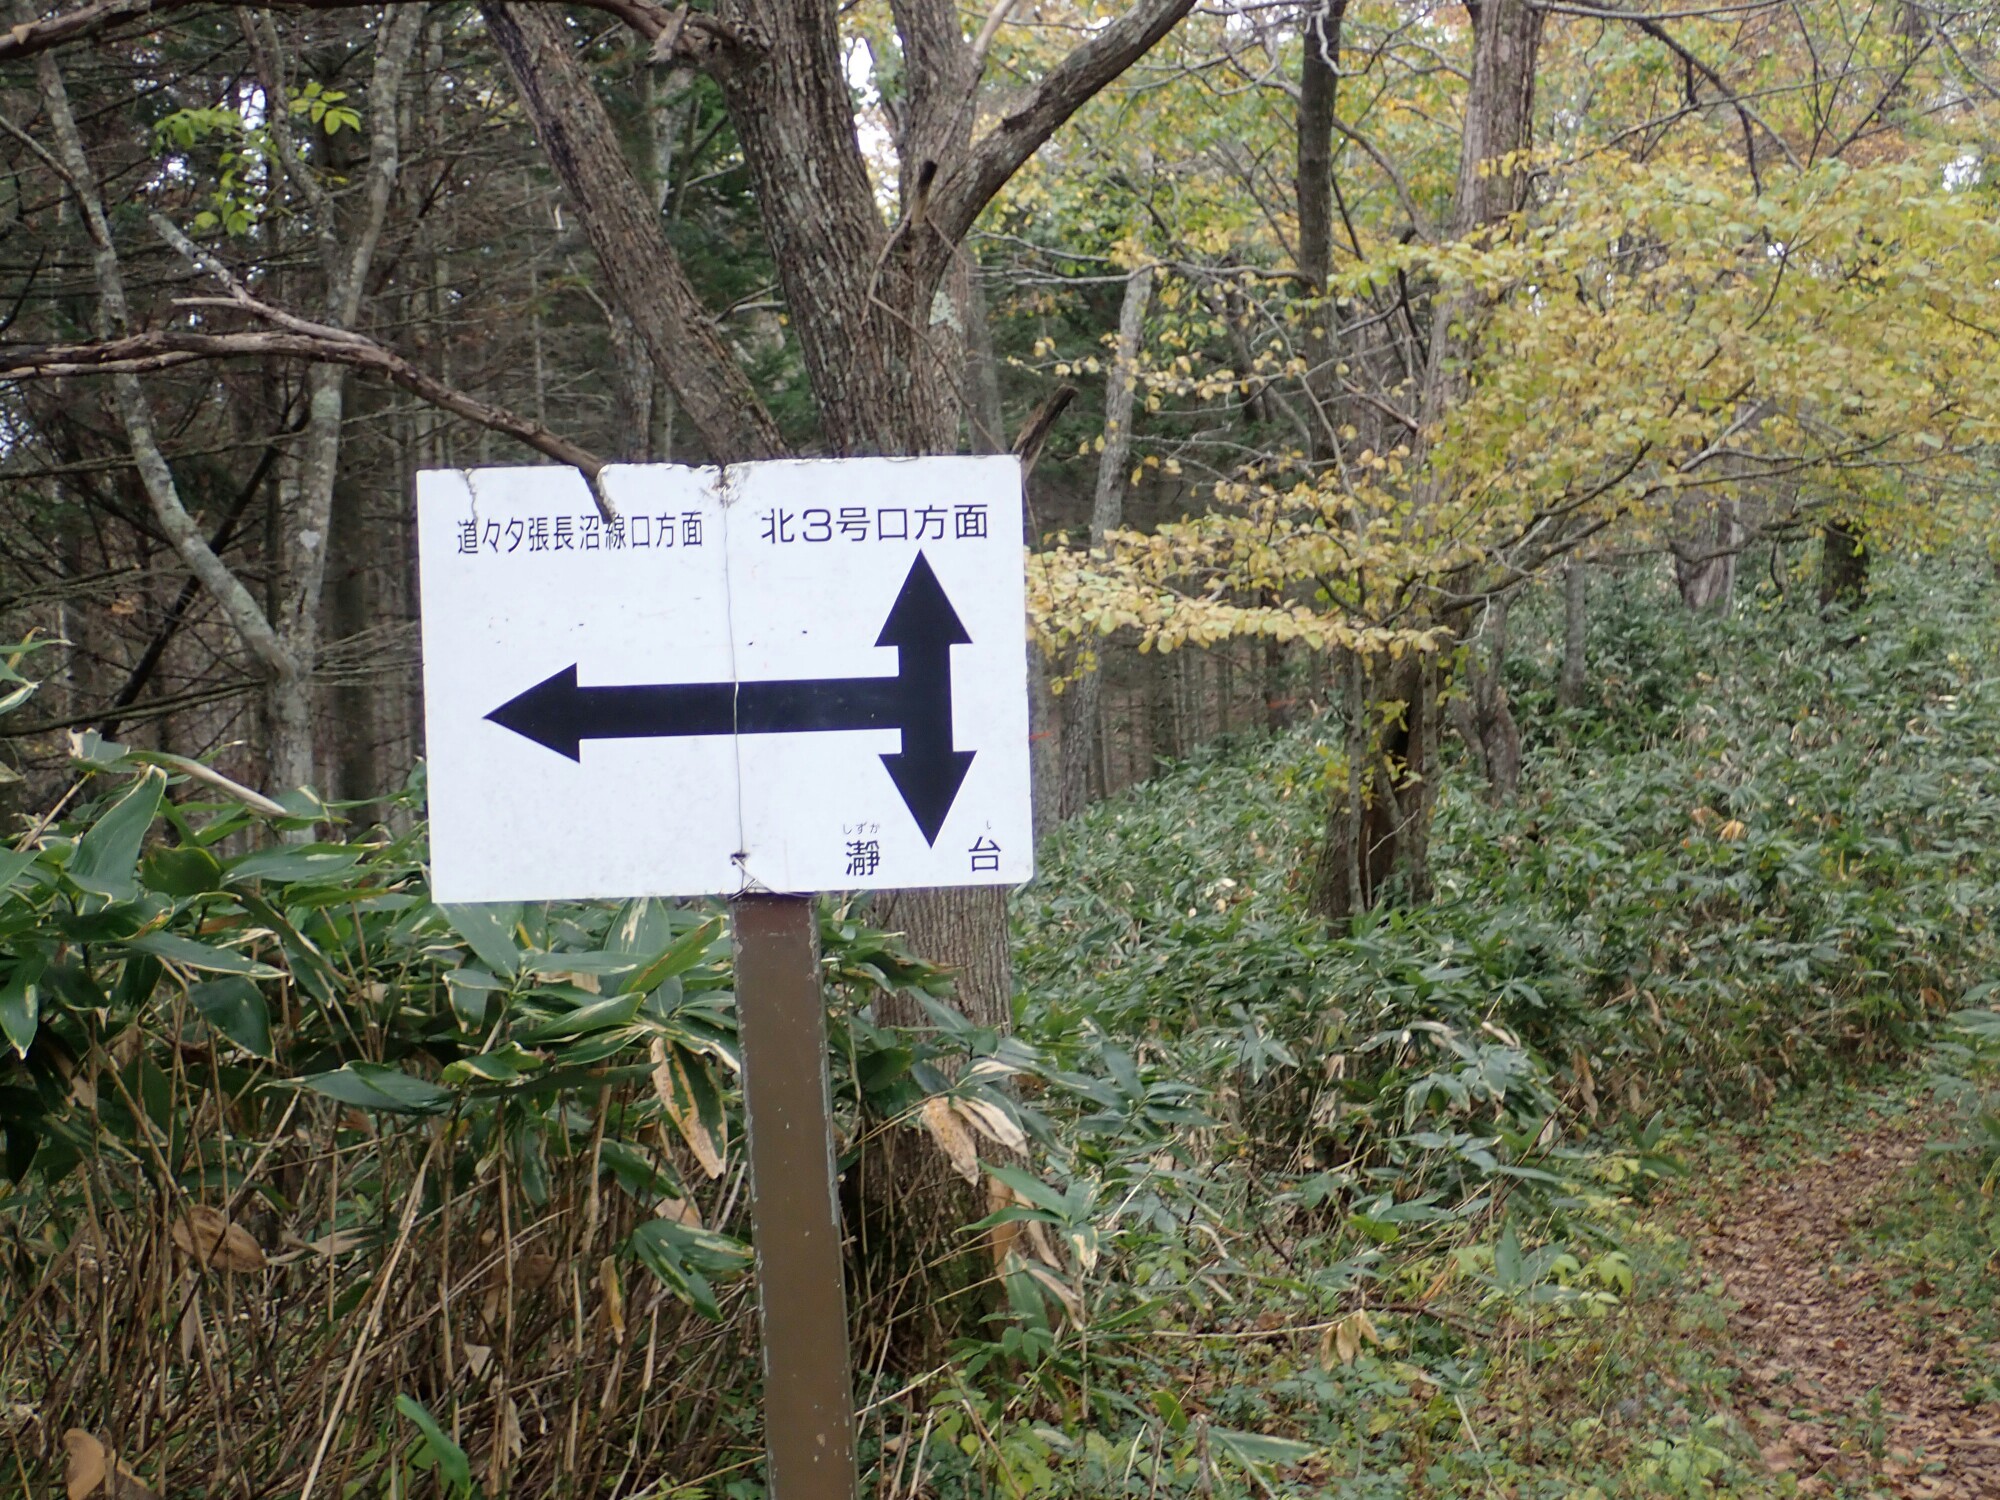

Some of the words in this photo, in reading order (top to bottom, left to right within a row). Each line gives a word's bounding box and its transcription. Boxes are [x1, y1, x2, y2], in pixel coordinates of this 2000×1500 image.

[761, 504, 988, 545] 北3号口方面
[968, 836, 1002, 873] 台
